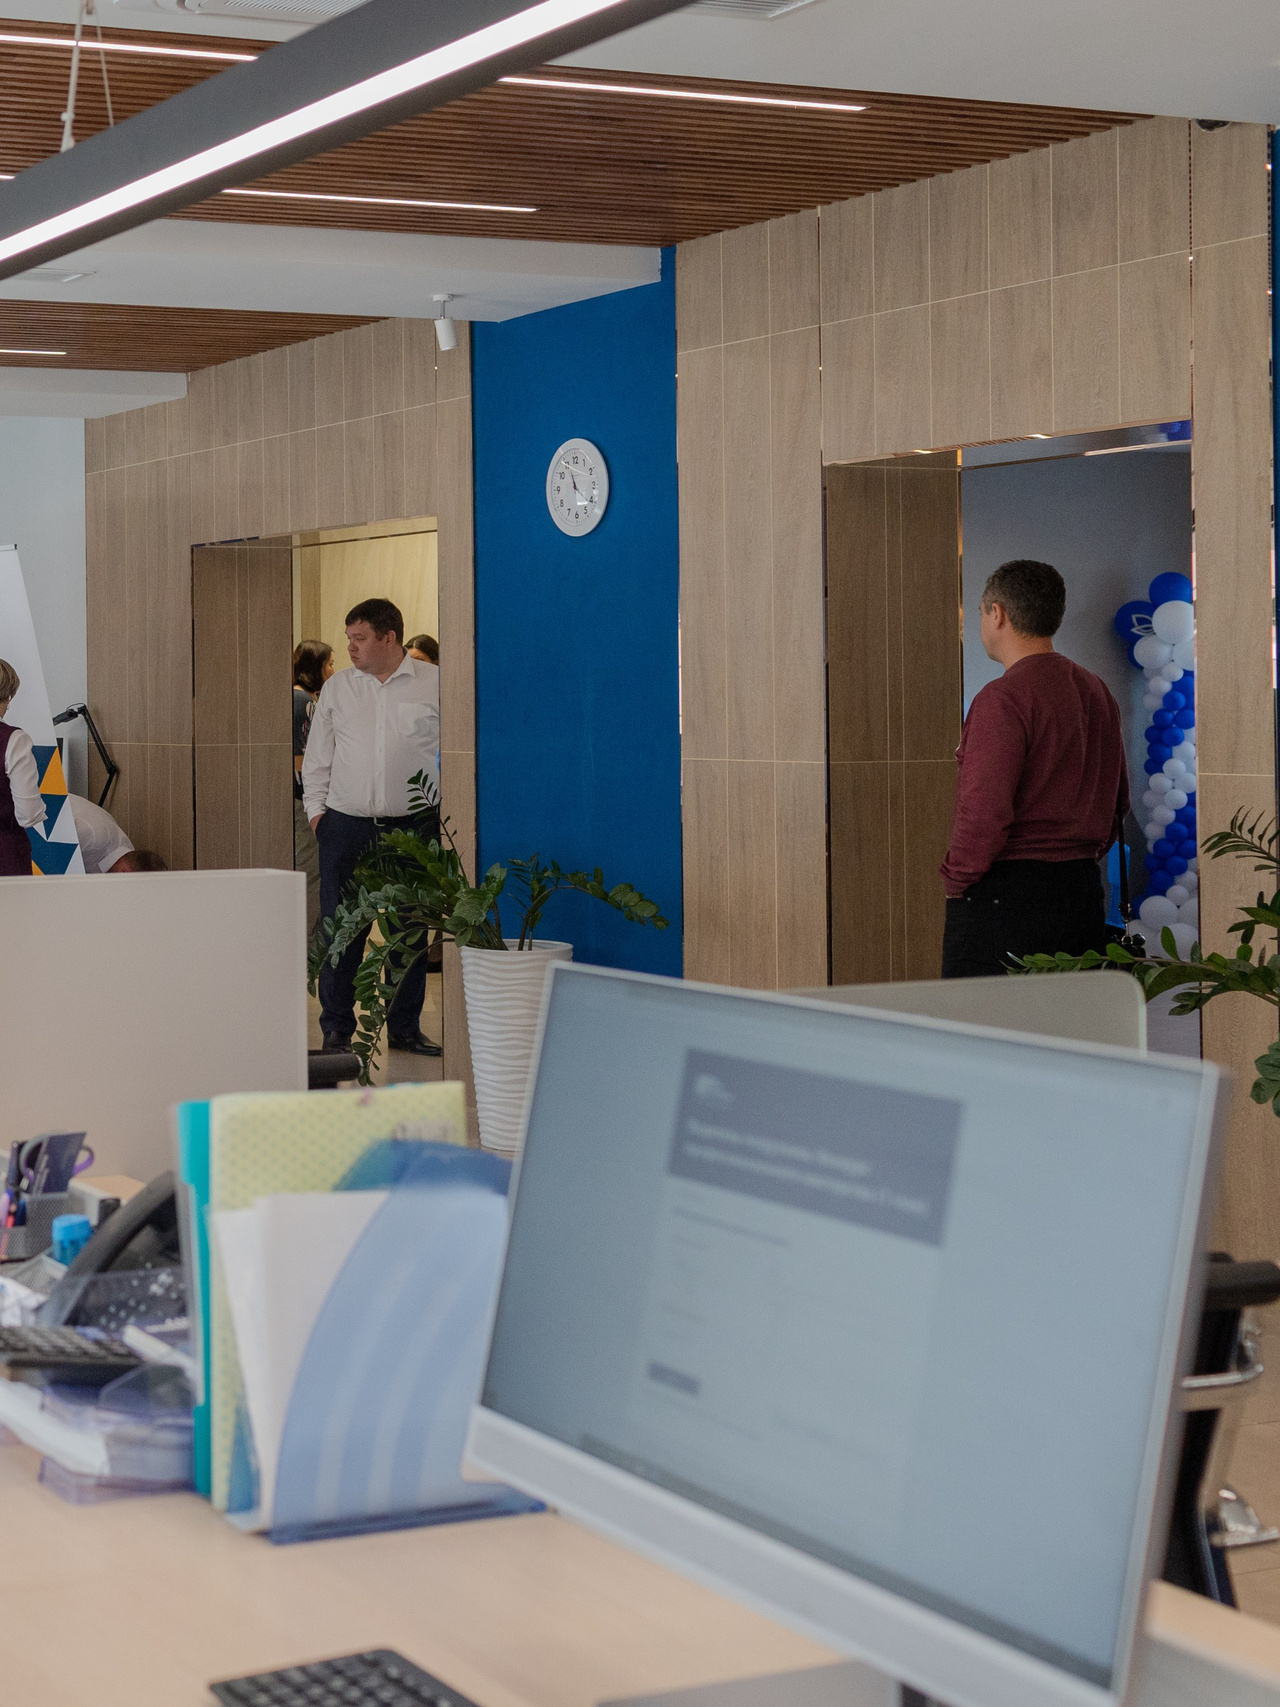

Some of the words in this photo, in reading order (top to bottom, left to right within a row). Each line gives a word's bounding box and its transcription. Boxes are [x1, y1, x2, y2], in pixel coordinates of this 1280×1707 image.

[572, 456, 579, 464] 12
[559, 471, 566, 480] 10
[588, 467, 593, 476] 2
[556, 485, 561, 494] 9
[591, 481, 596, 490] 3
[560, 499, 564, 508] 8
[589, 495, 594, 504] 4
[567, 508, 571, 517] 7
[583, 506, 588, 515] 5
[574, 511, 579, 520] 6
